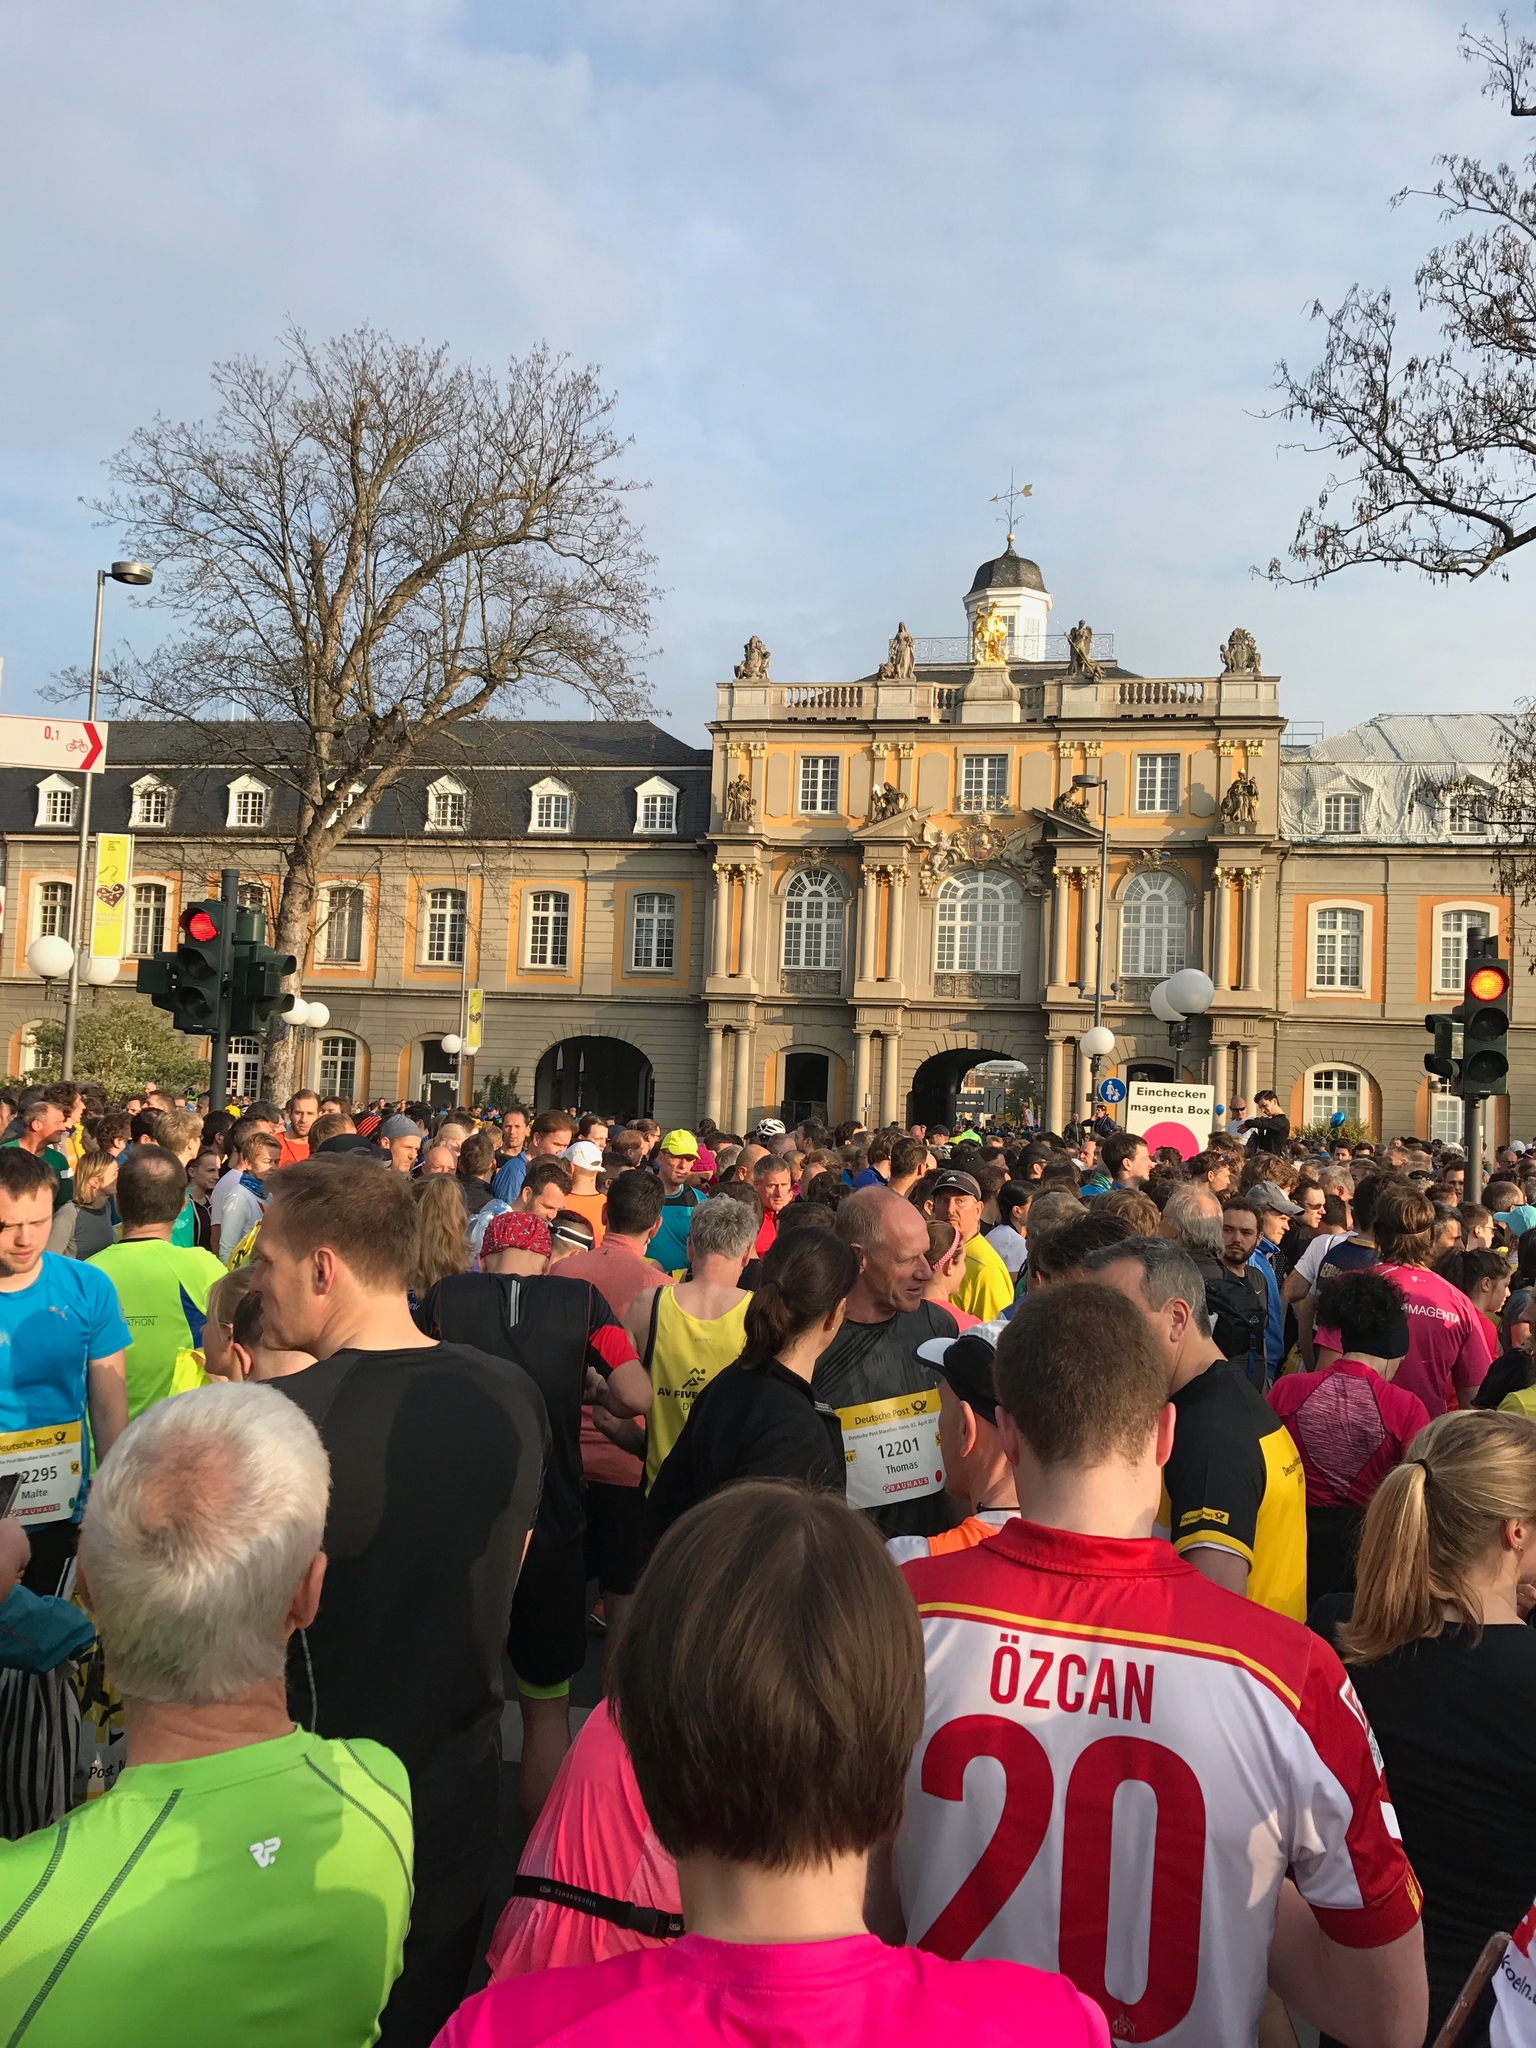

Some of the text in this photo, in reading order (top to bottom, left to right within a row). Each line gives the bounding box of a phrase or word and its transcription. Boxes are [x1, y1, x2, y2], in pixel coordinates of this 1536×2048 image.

[1136, 1086, 1207, 1099] Einchecken
[1130, 1104, 1210, 1115] magenta Box
[657, 1387, 672, 1397] AV
[854, 1406, 910, 1426] Deutsche Post
[0, 1437, 53, 1452] eutsche Post
[877, 1437, 920, 1459] 12201
[20, 1465, 58, 1485] 2295
[885, 1461, 919, 1475] Thomas
[890, 1477, 929, 1492] BAUHAUS
[21, 1488, 48, 1500] Malte
[990, 1633, 1154, 1724] ÖZCAN
[88, 1763, 115, 1780] Post
[917, 1713, 1207, 2044] 20
